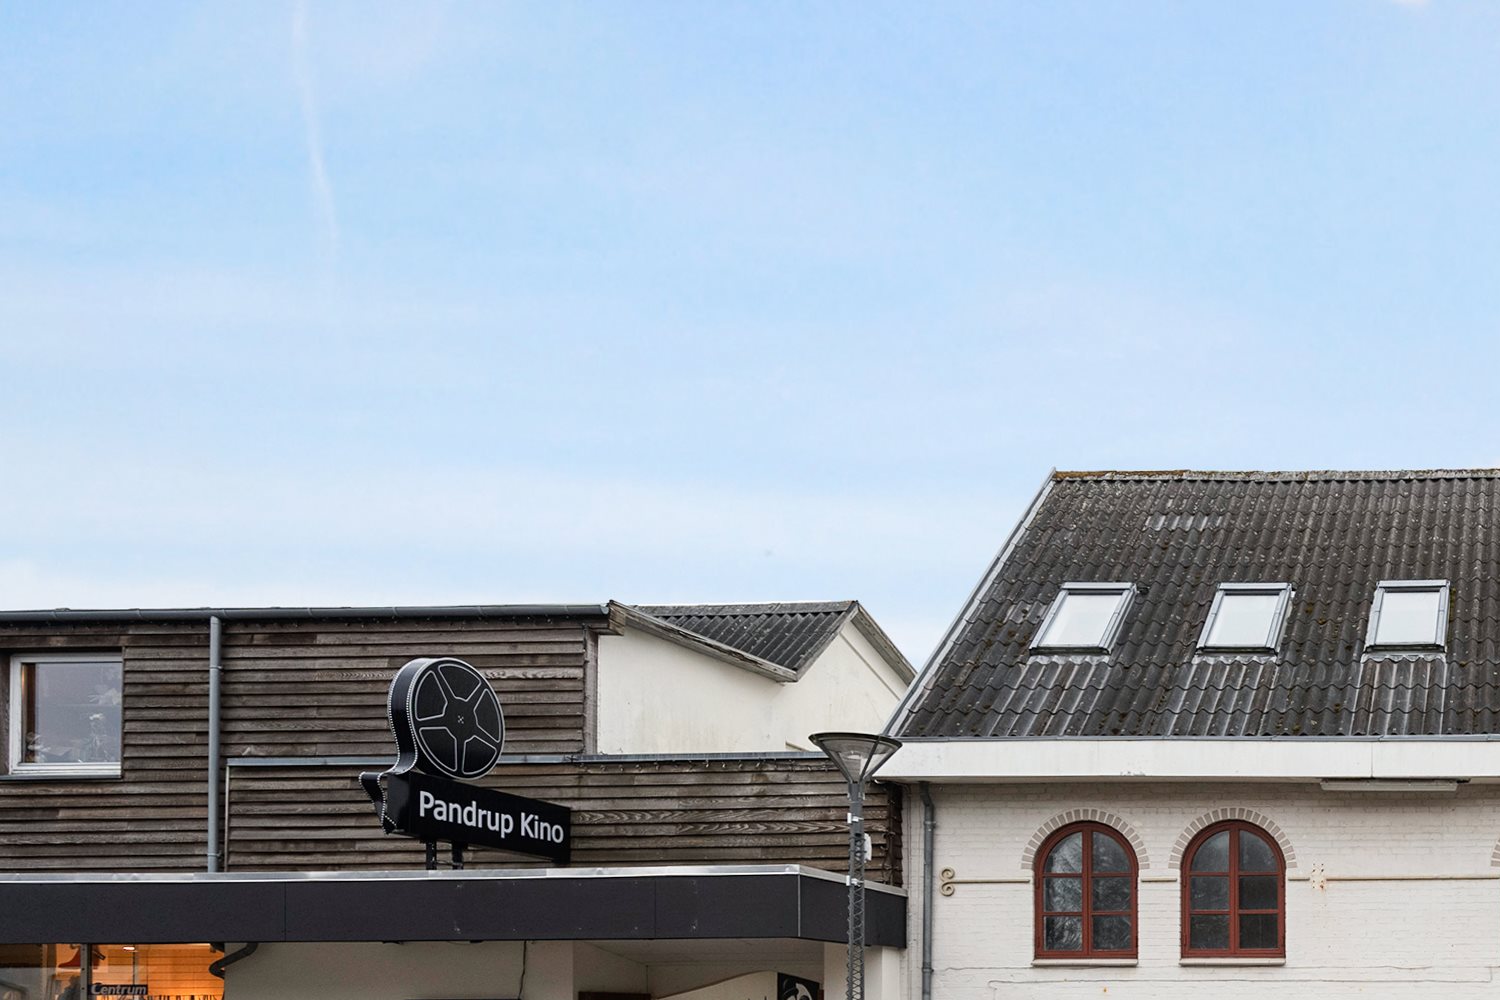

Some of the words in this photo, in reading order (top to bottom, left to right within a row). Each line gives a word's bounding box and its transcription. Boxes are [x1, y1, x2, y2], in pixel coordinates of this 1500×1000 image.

[419, 791, 514, 839] Pandrup
[520, 812, 564, 844] Kino
[91, 983, 147, 995] Centrum
